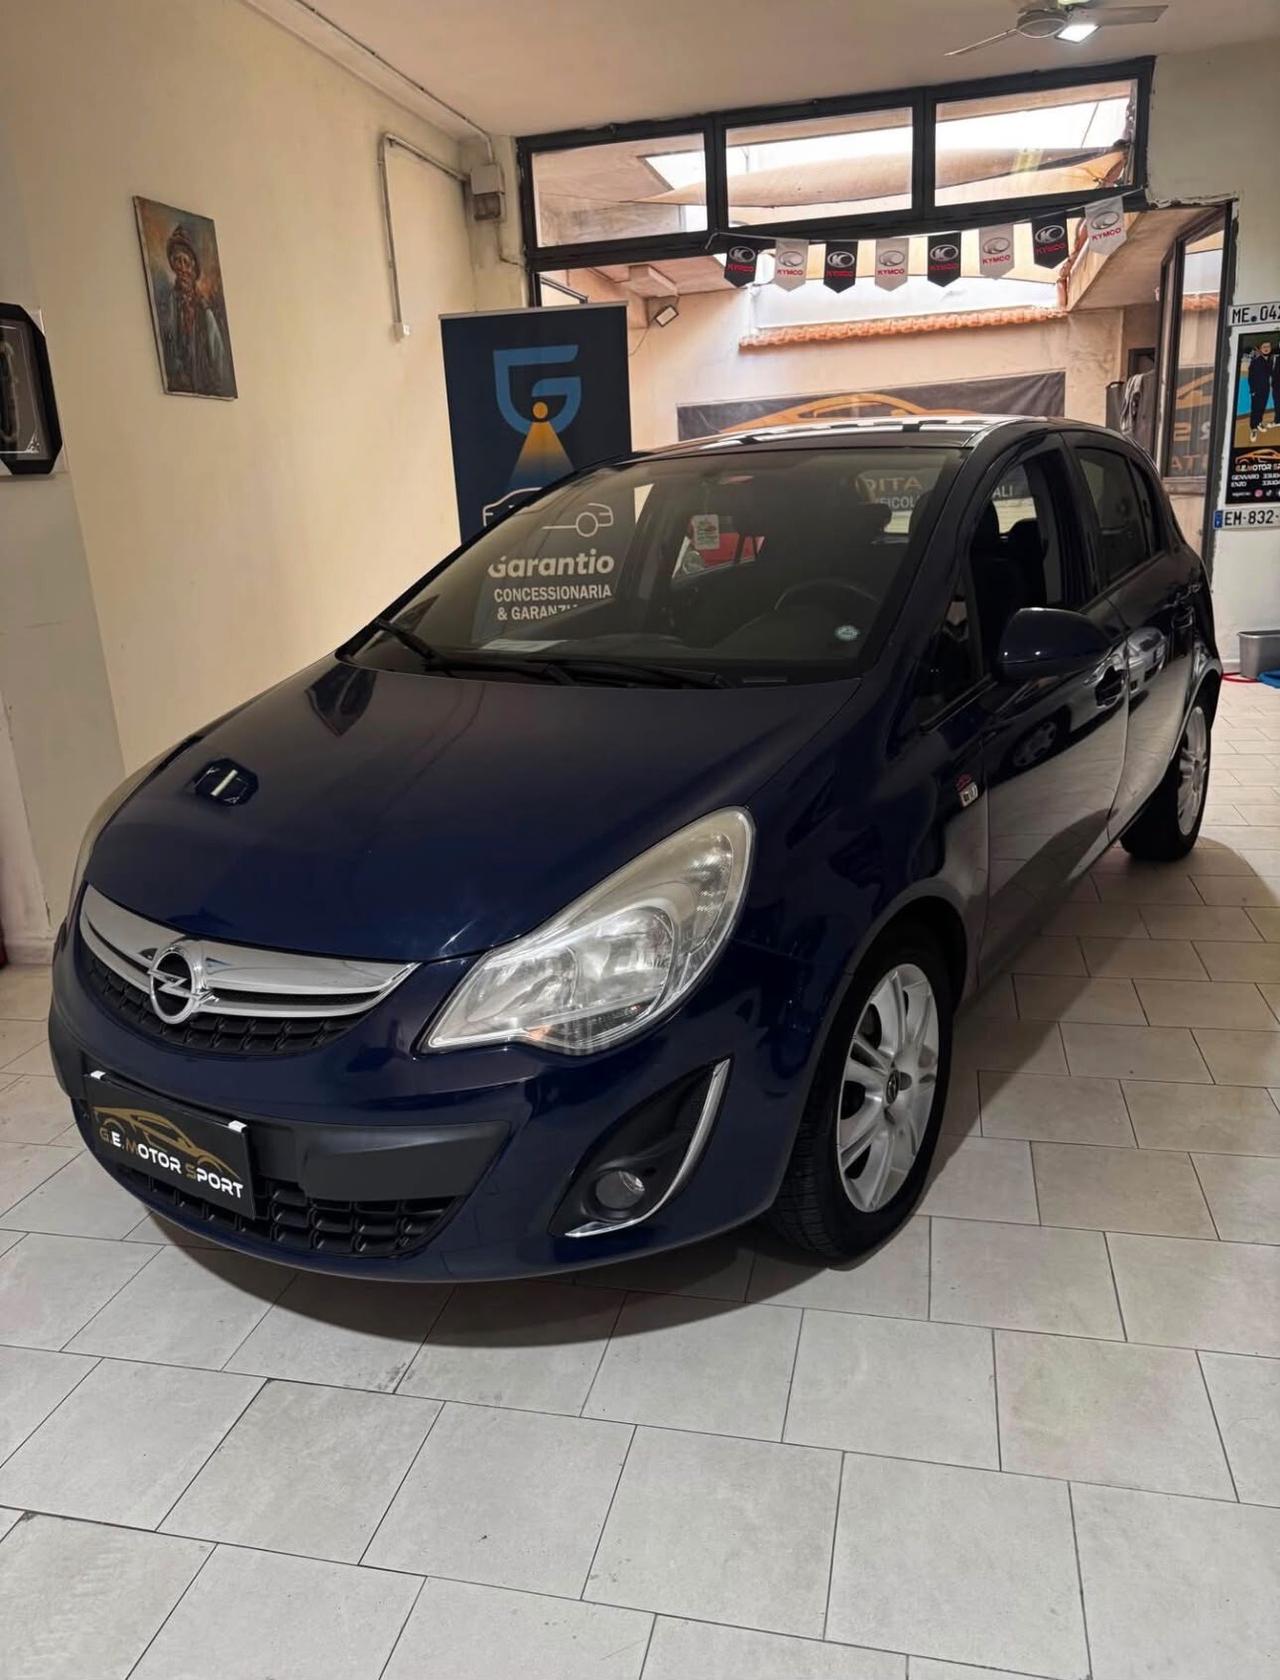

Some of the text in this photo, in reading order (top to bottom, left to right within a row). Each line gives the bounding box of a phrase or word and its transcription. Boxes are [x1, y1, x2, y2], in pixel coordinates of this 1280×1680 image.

[1091, 227, 1121, 241] KYMCO
[1035, 242, 1066, 254] KYMCO
[929, 262, 959, 271] KYMCO
[982, 254, 1011, 265] KYMCO
[488, 548, 614, 577] Garantio
[494, 585, 612, 603] CONCESSIONARIA
[497, 607, 508, 621] &
[185, 1162, 244, 1198] SPORT
